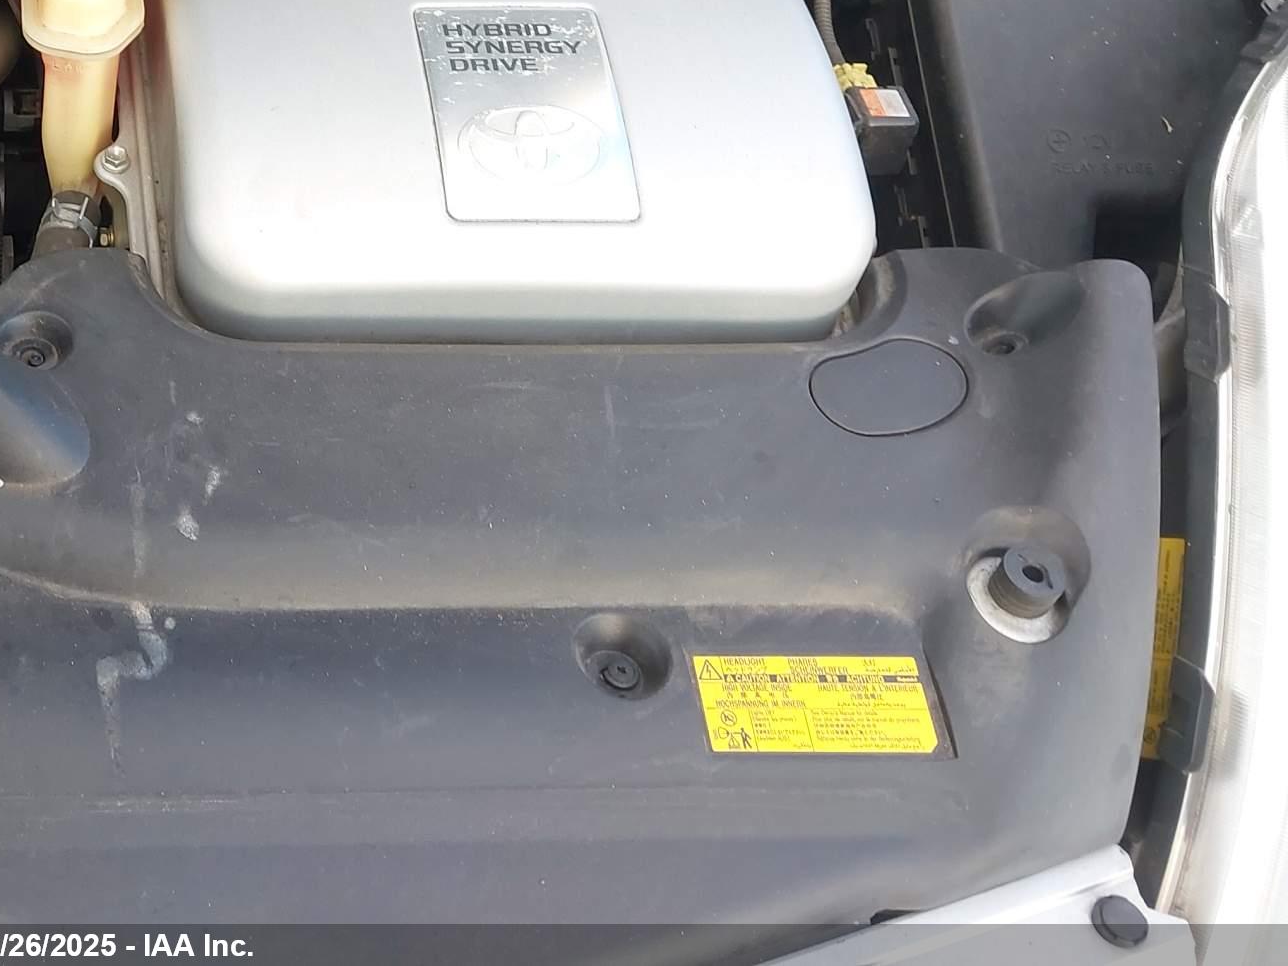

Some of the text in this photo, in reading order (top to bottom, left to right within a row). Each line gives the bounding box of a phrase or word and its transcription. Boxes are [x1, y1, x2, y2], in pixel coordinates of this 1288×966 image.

[442, 24, 553, 37] HYBRID
[446, 40, 581, 54] SYNERGY
[450, 58, 539, 72] DRIVE
[735, 675, 769, 683] CAUTION
